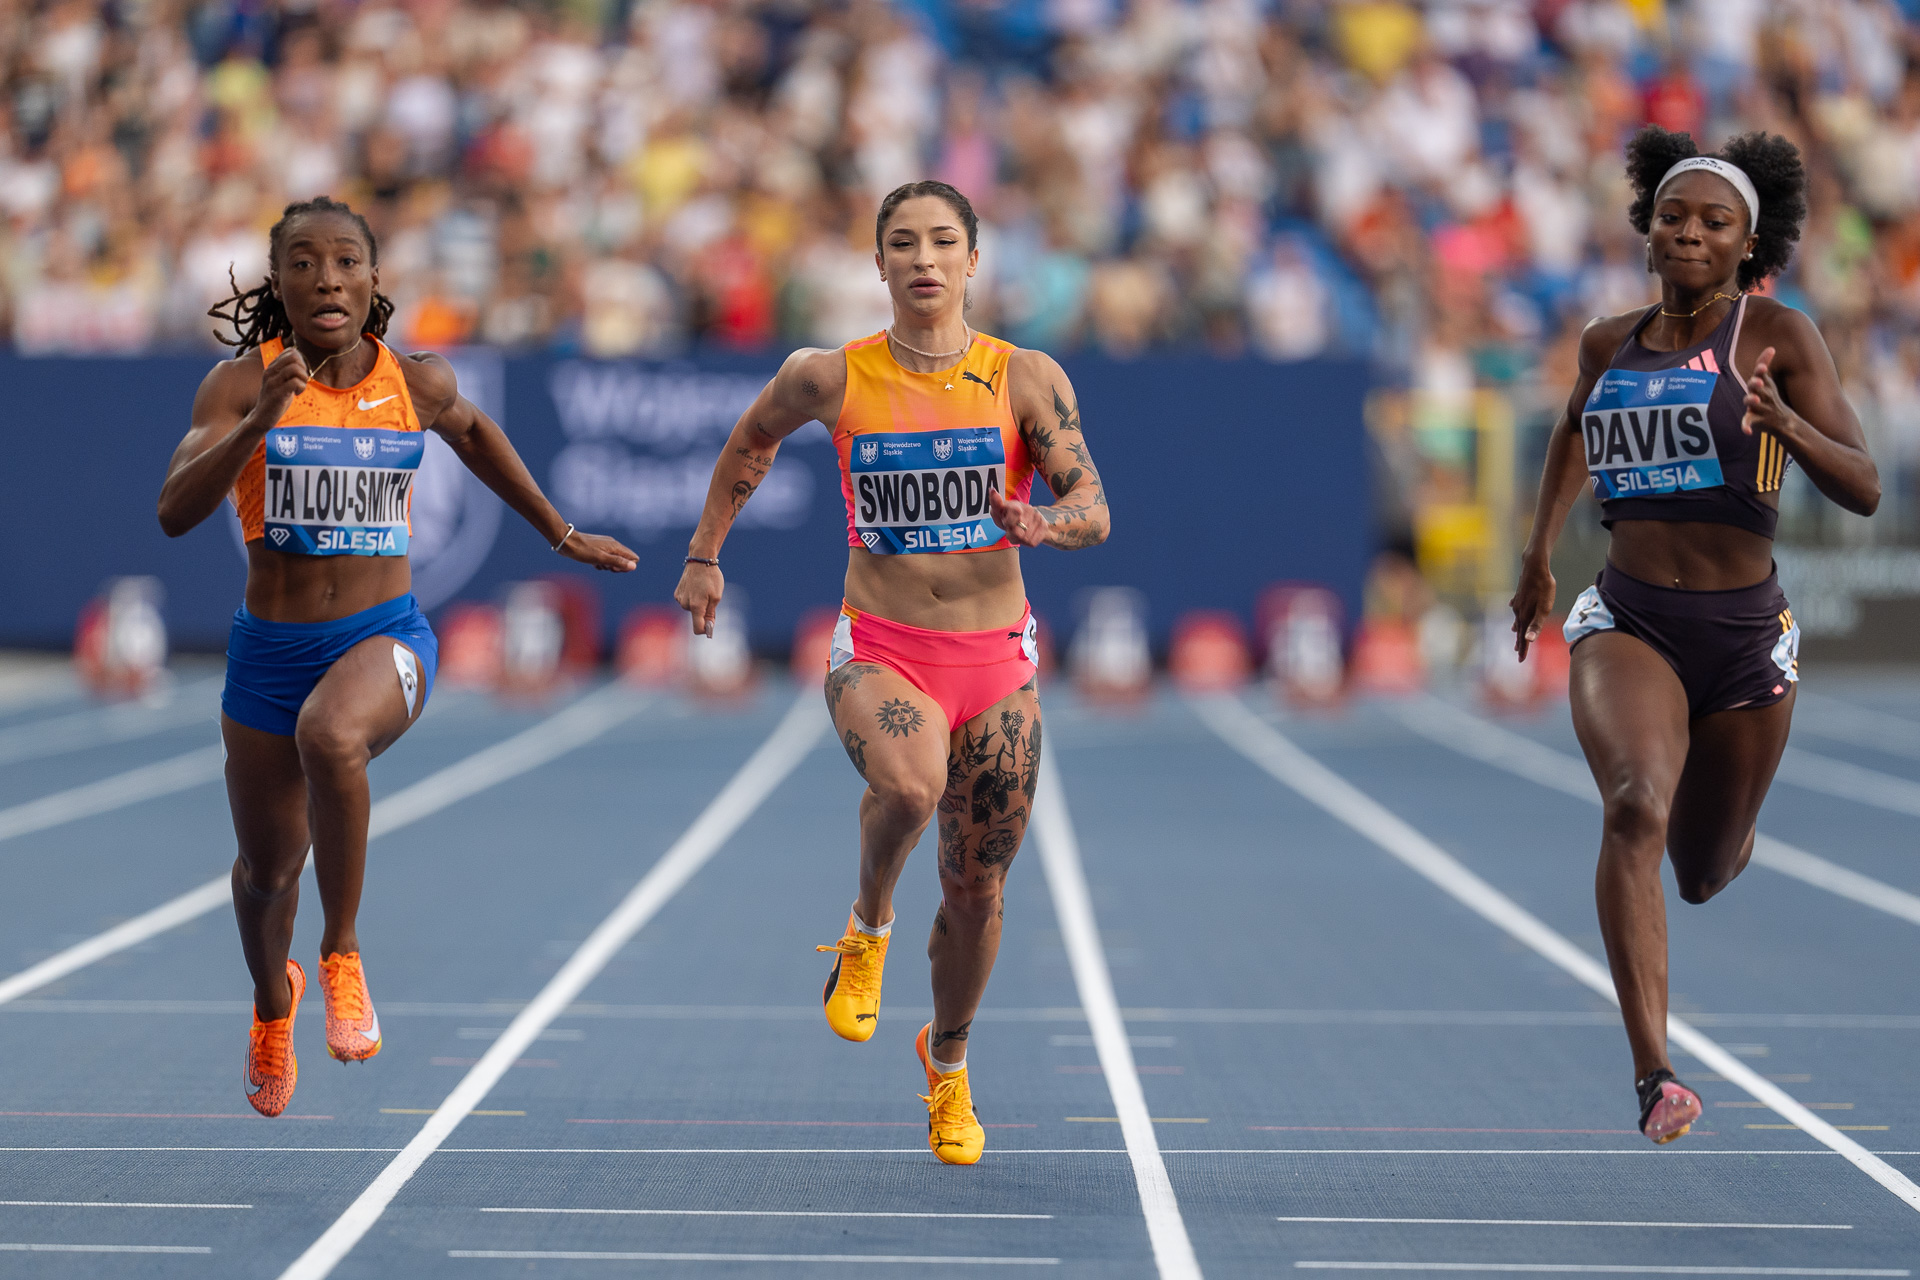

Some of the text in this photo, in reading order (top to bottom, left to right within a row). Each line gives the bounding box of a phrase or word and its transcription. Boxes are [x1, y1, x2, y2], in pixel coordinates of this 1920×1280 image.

[957, 437, 994, 445] Województwo
[1585, 407, 1710, 466] DAVIS
[1616, 465, 1701, 492] SILESIA
[268, 468, 413, 523] TA LOU-SMITH
[858, 467, 1000, 523] SWOBODA
[317, 530, 396, 551] SILESIA
[904, 524, 988, 549] SILESIA
